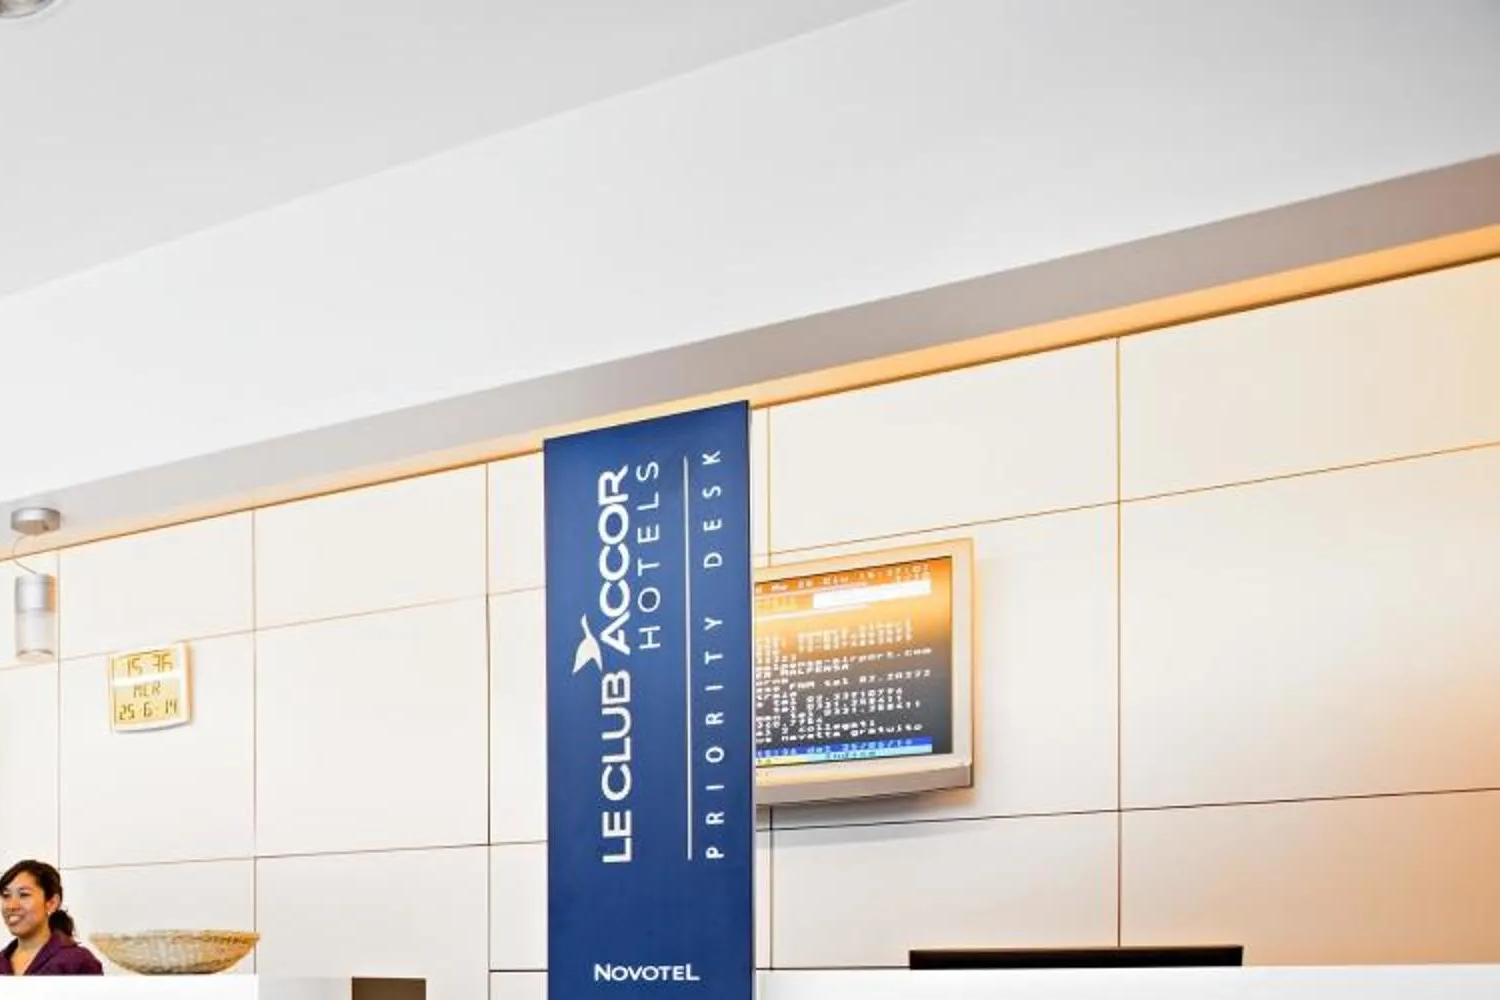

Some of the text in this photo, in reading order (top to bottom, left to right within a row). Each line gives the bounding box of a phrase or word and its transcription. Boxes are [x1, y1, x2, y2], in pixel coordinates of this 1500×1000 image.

[597, 463, 633, 864] LE CLUB ACCOR
[635, 460, 661, 651] HOTELS
[701, 449, 725, 860] PRIORITY DESK
[594, 963, 700, 981] NOVOTEL
